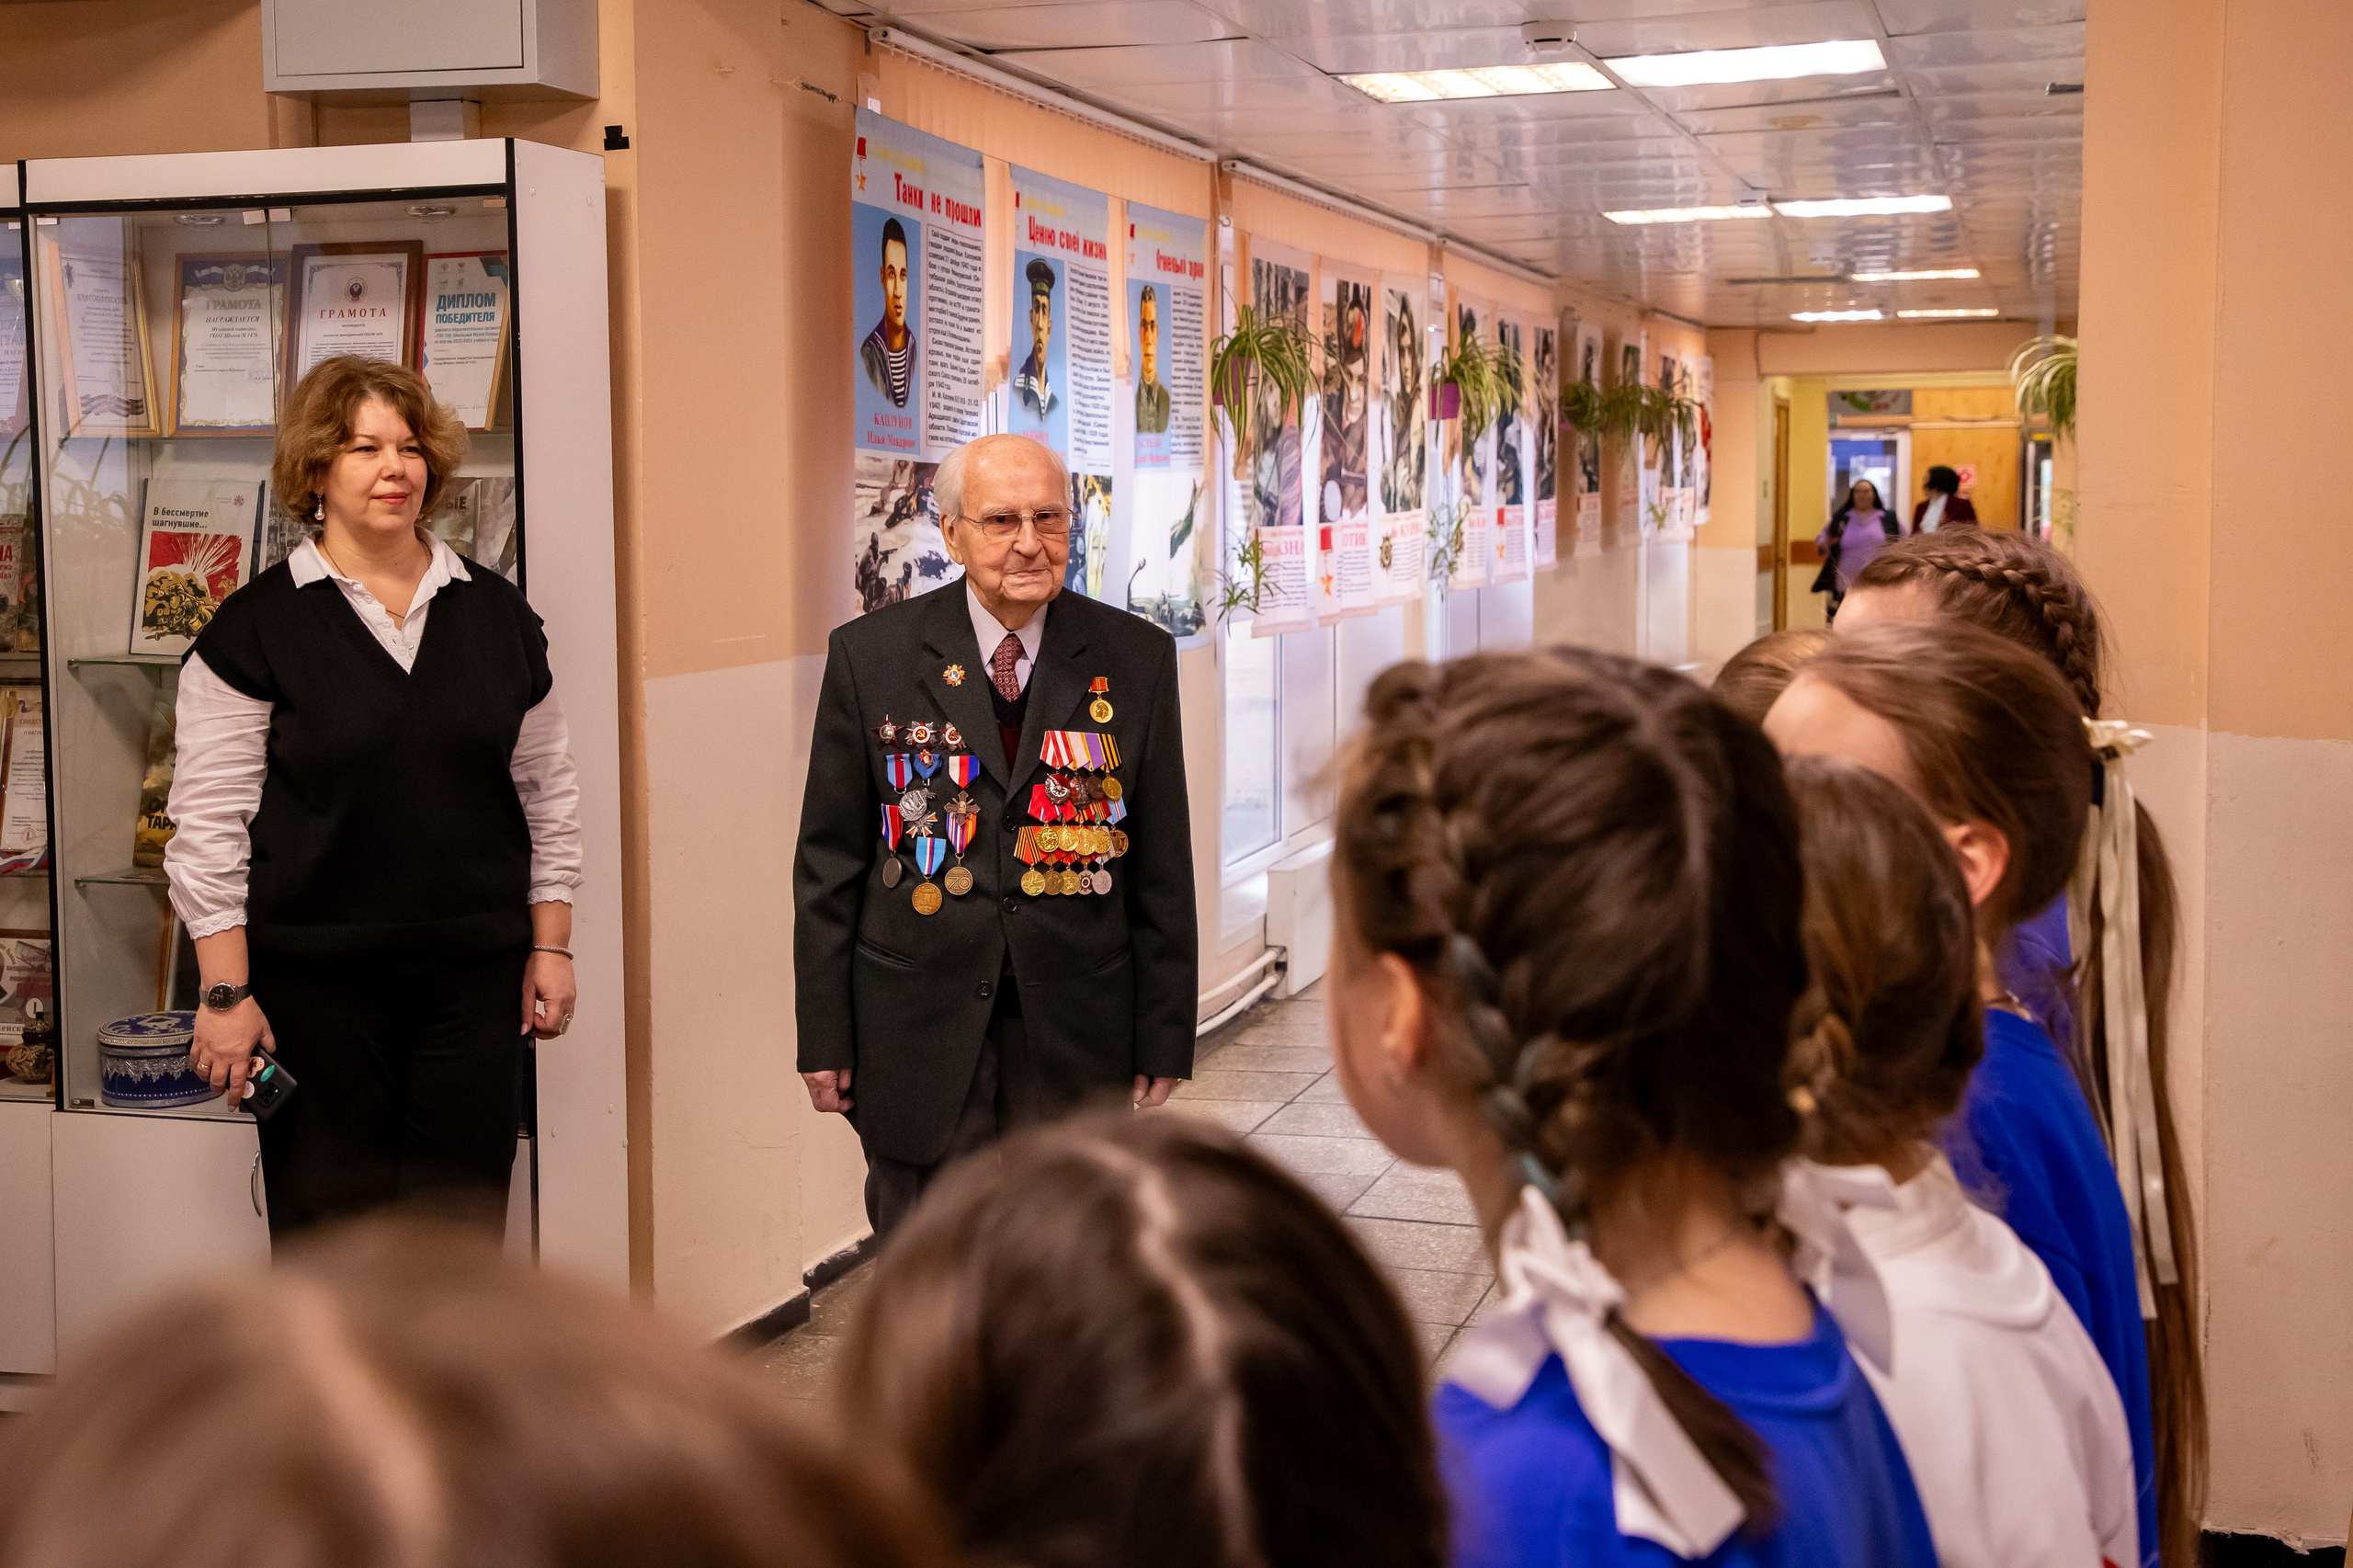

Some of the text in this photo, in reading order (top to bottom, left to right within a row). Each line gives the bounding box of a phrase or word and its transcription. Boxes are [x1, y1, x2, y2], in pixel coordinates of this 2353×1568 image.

[894, 172, 982, 228] Танки не прошли
[206, 299, 262, 311] ГРАМОТА
[437, 292, 496, 312] ДИПЛОМ
[320, 308, 386, 319] ГРАМОТА
[436, 312, 494, 324] ПОБЕДИТЕЛЯ
[153, 506, 209, 518] В бессмертие
[153, 519, 208, 528] шагнувшие...
[947, 875, 972, 890] 70
